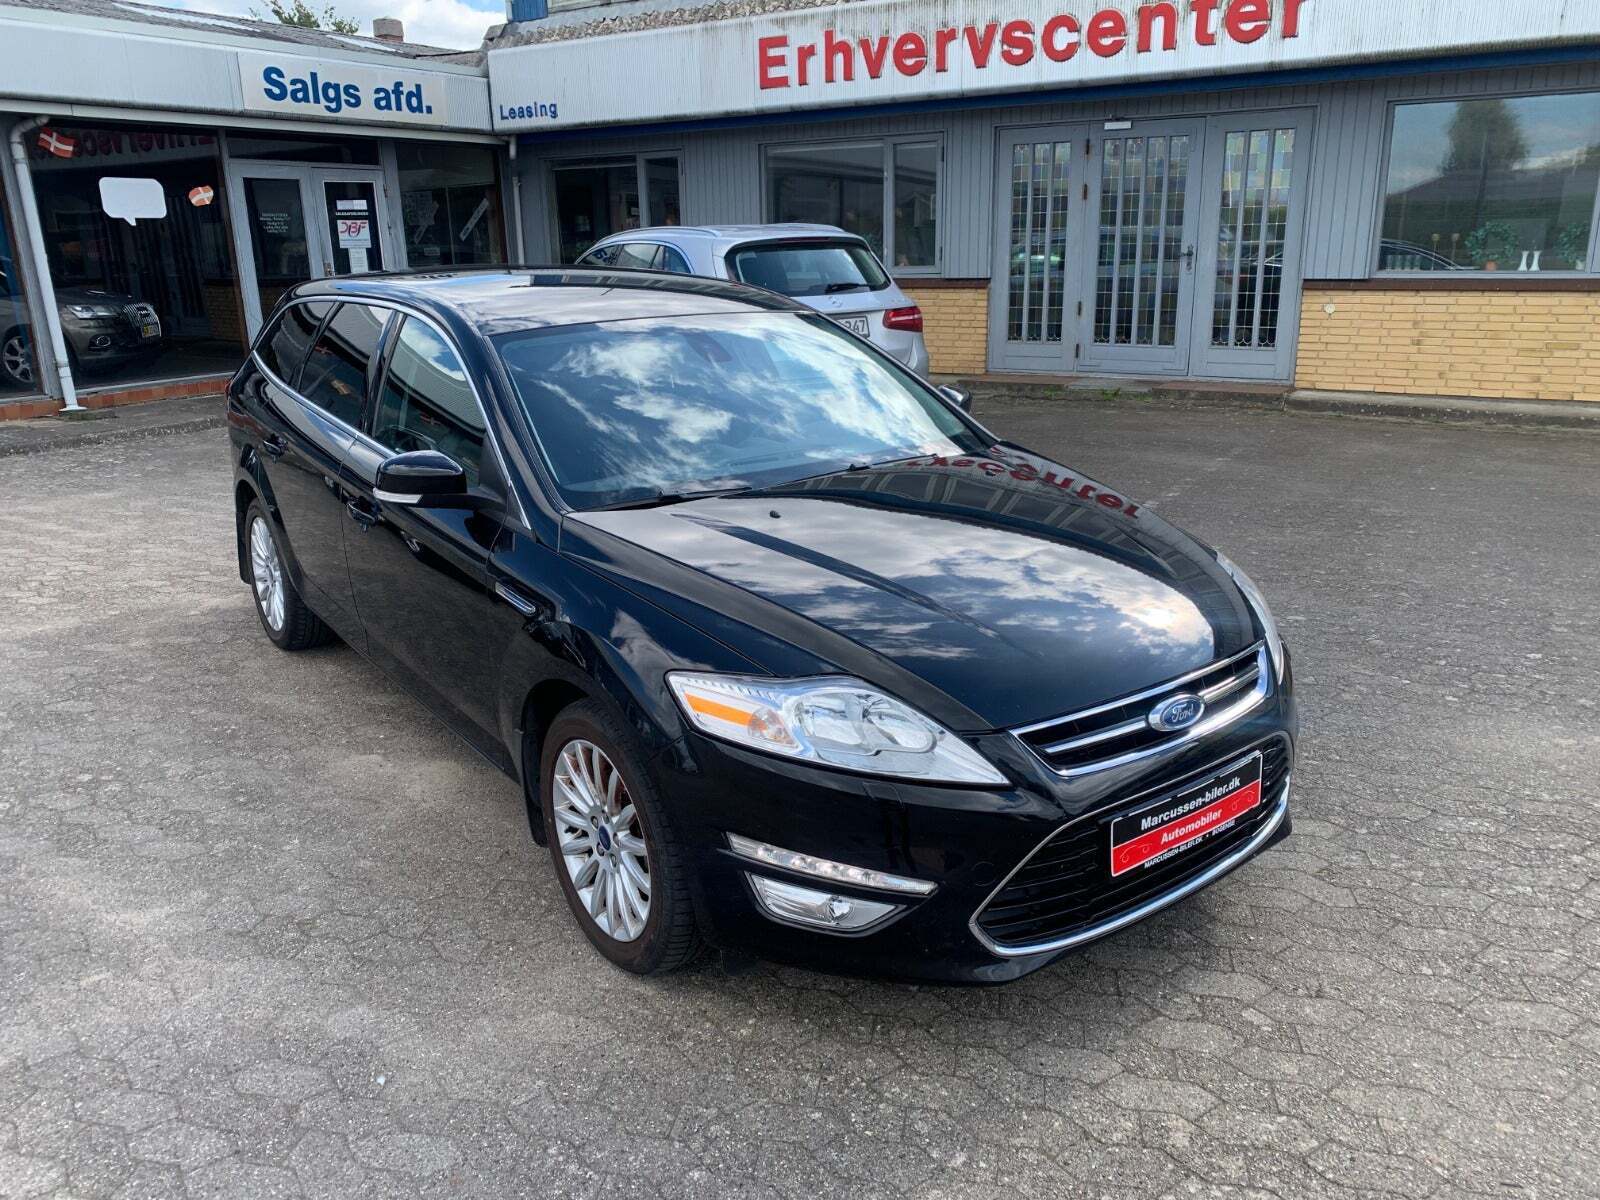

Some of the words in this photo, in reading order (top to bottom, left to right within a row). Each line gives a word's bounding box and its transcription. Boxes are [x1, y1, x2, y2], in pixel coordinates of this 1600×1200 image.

[758, 0, 1305, 89] Erhvervscenter
[262, 66, 362, 113] Salgs
[373, 81, 433, 114] afd.
[500, 102, 558, 121] Leasing
[1171, 703, 1194, 722] Ford
[1141, 776, 1241, 830] Marcussen-biler.dk
[1160, 809, 1222, 844] Automobiler
